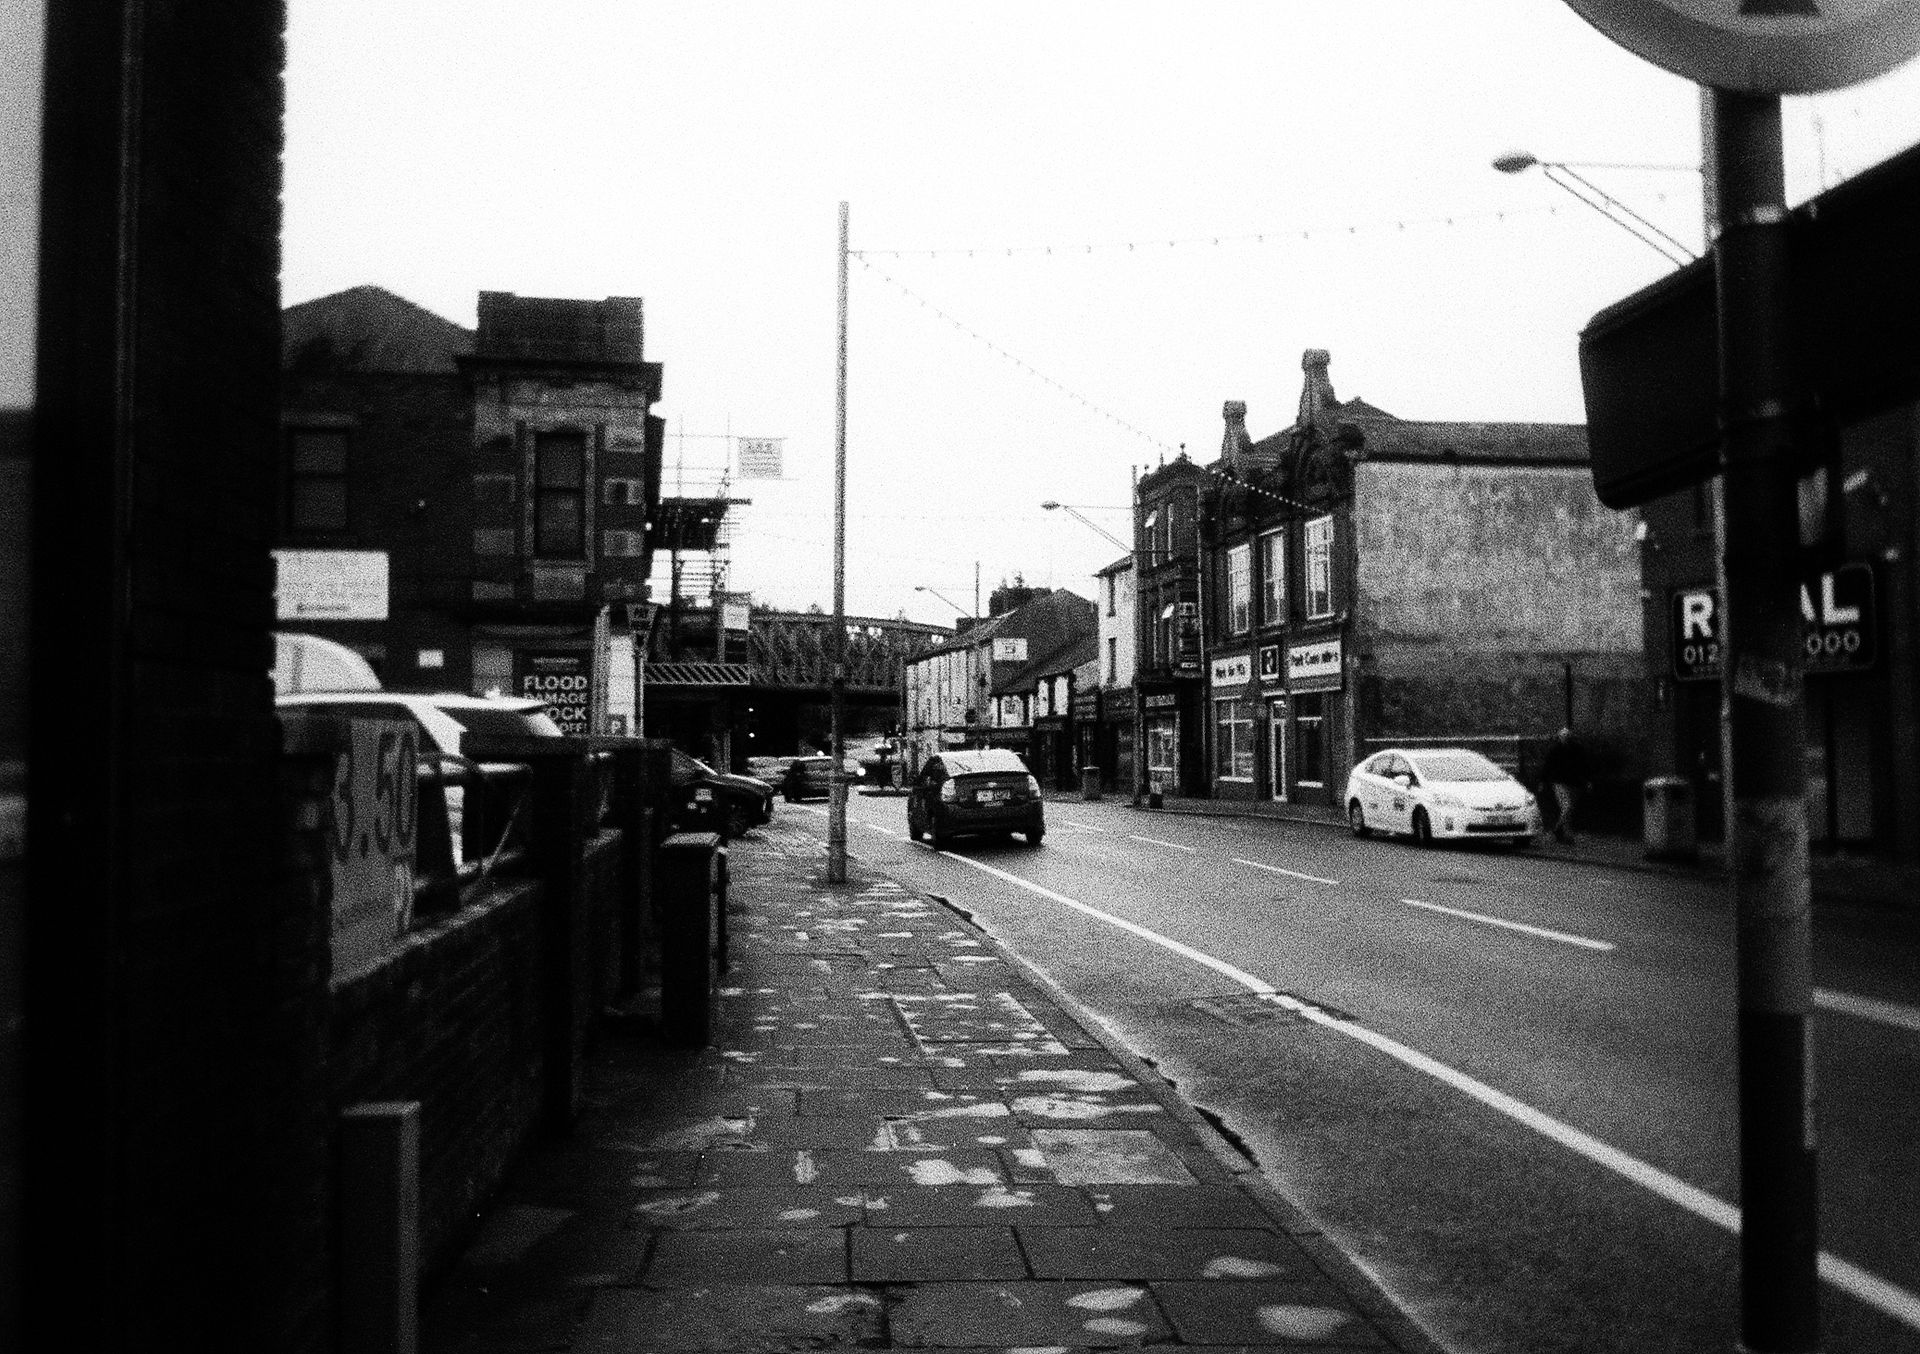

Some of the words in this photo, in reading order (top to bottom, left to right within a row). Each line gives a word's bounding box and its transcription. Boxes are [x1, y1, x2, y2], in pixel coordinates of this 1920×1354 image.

[1683, 643, 1719, 665] 012
[1806, 630, 1861, 655] 000
[523, 675, 588, 691] FLOOD
[546, 706, 587, 721] OCK
